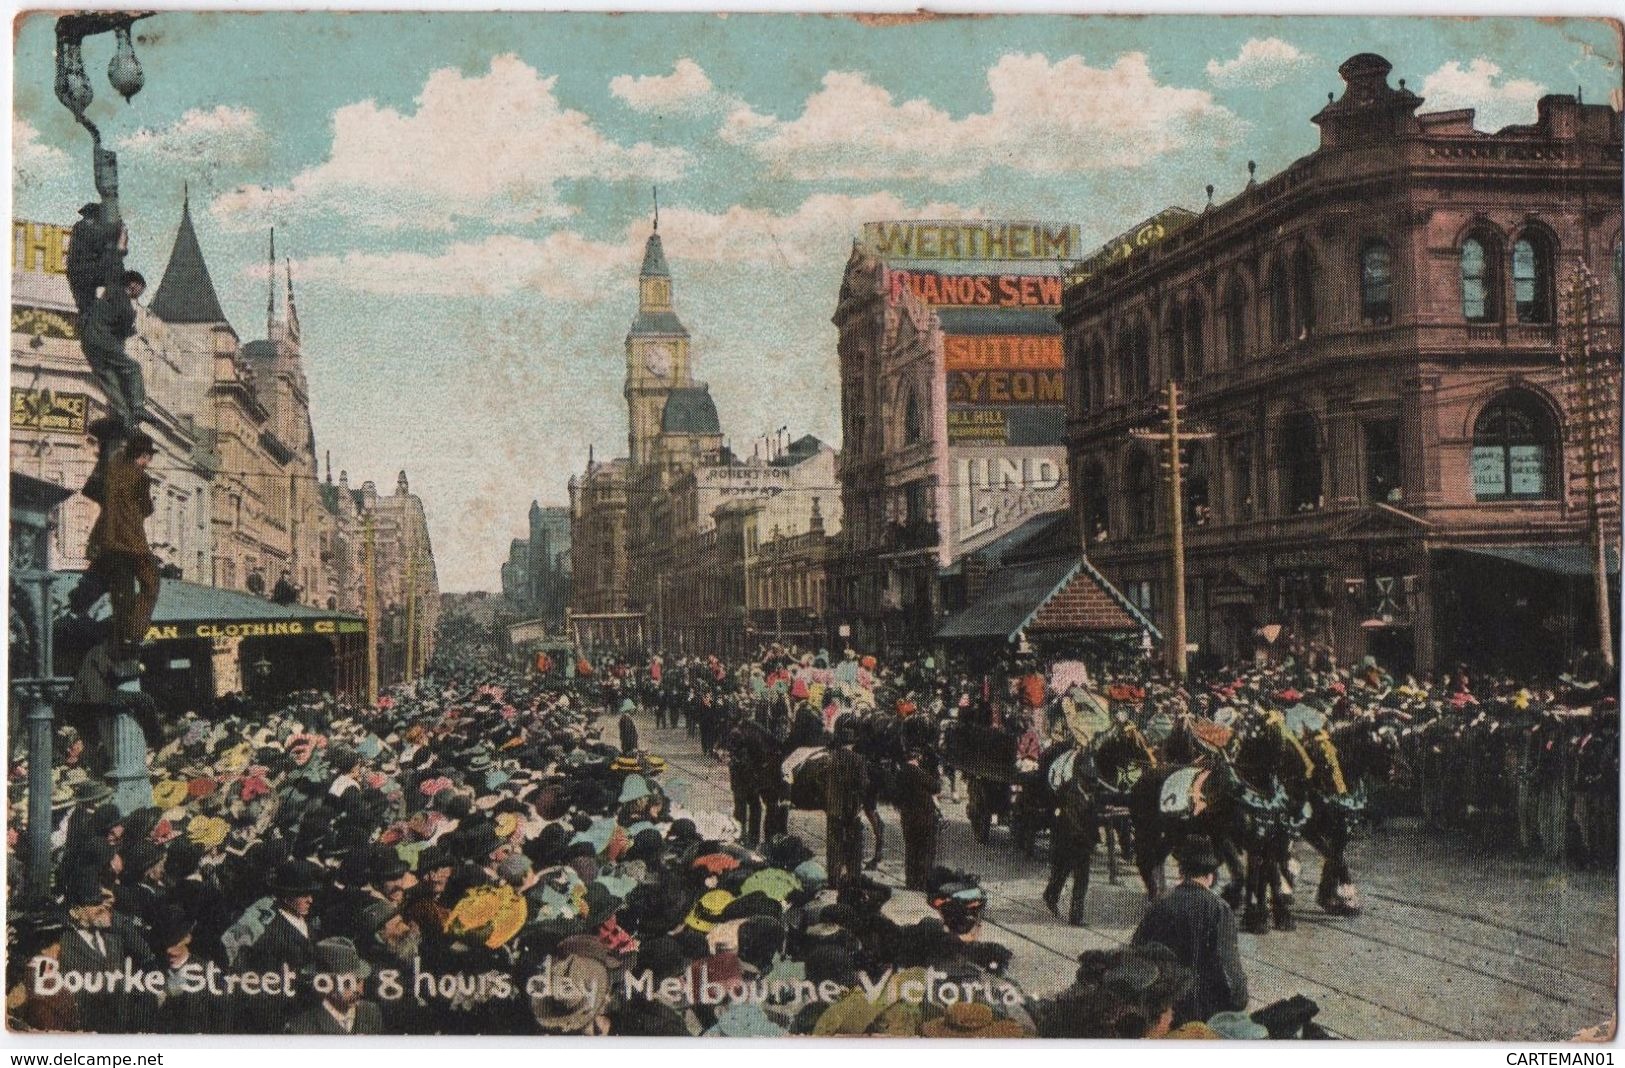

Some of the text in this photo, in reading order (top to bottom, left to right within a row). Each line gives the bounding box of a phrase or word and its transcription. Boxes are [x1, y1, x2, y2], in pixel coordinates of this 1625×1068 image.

[876, 222, 1081, 258] WERTHEIM
[889, 270, 1063, 307] PIANOS SEW
[957, 457, 1062, 542] LIND
[196, 621, 303, 638] CLOTHING
